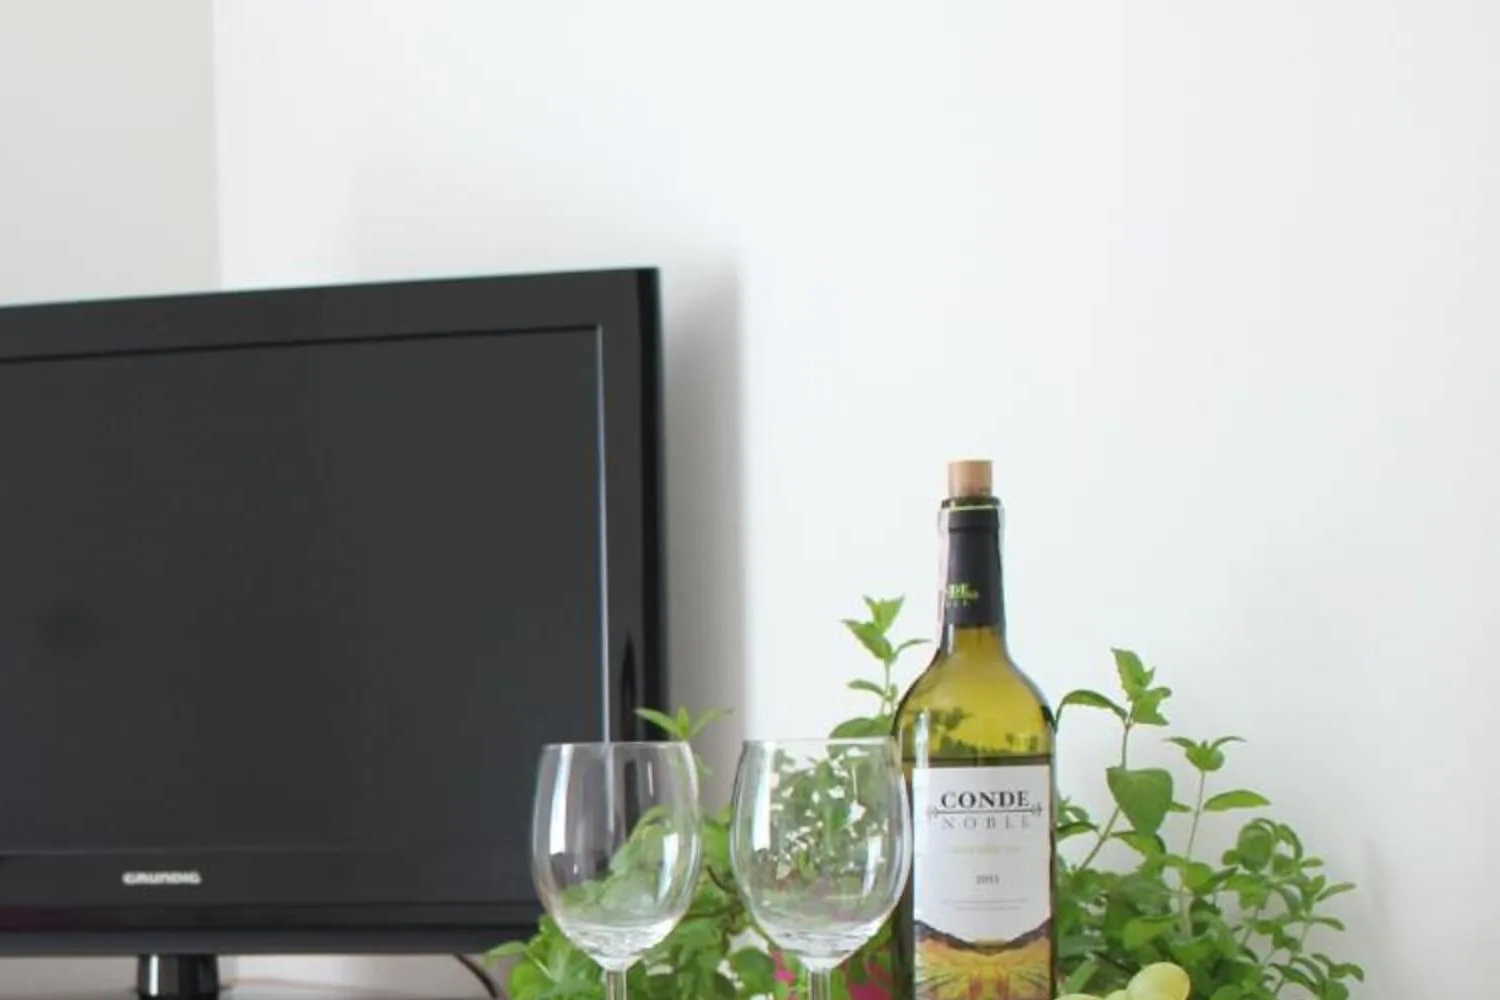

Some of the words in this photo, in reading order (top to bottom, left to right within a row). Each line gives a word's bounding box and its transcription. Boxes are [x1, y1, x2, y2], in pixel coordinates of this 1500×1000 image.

[941, 790, 1029, 808] CONDE
[941, 815, 1030, 830] NOBLE
[122, 871, 202, 886] GRUNDIG
